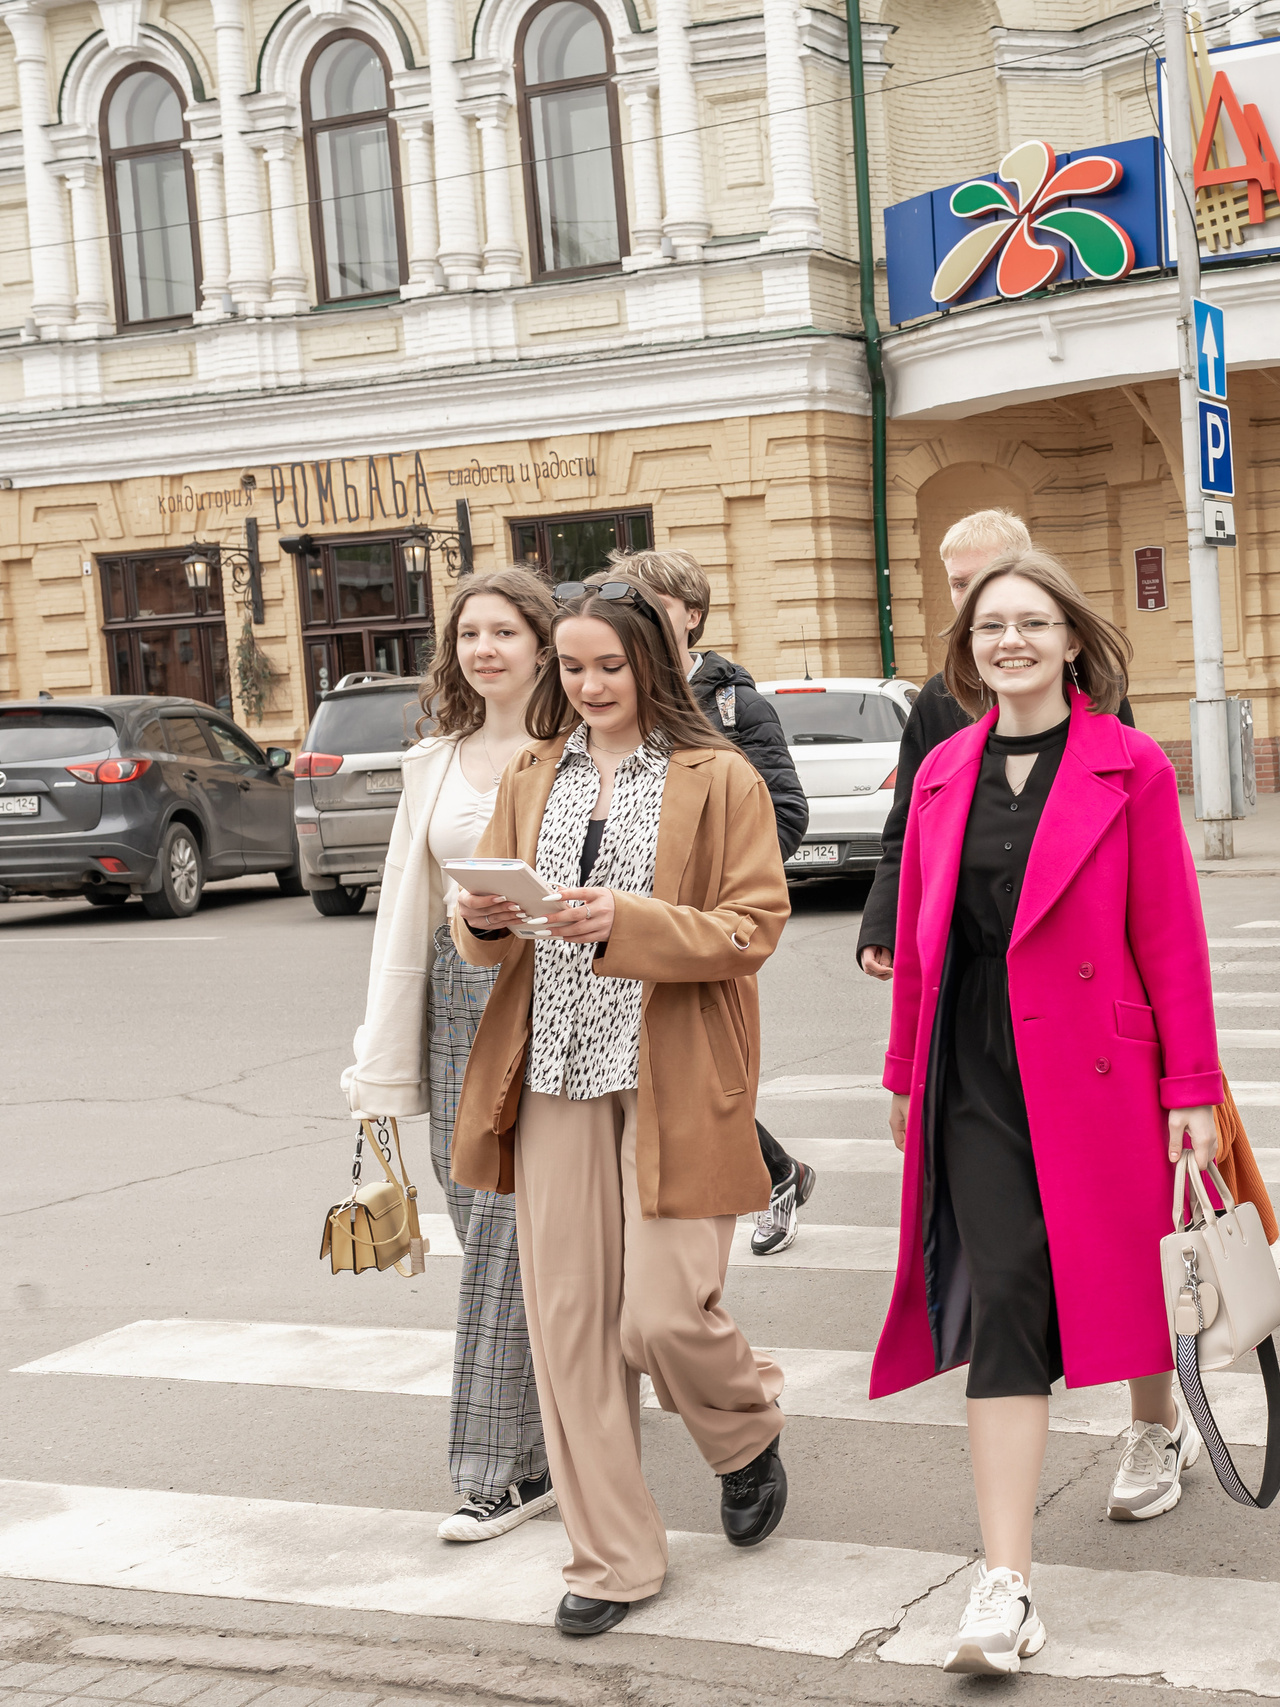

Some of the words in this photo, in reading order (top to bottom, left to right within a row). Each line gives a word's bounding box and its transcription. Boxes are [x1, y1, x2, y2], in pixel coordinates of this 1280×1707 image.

[448, 458, 515, 487] сладости
[520, 462, 531, 483] и
[533, 450, 597, 490] радости
[158, 485, 253, 515] кондитория
[271, 450, 435, 530] РОМБАБА
[813, 845, 835, 857] 124
